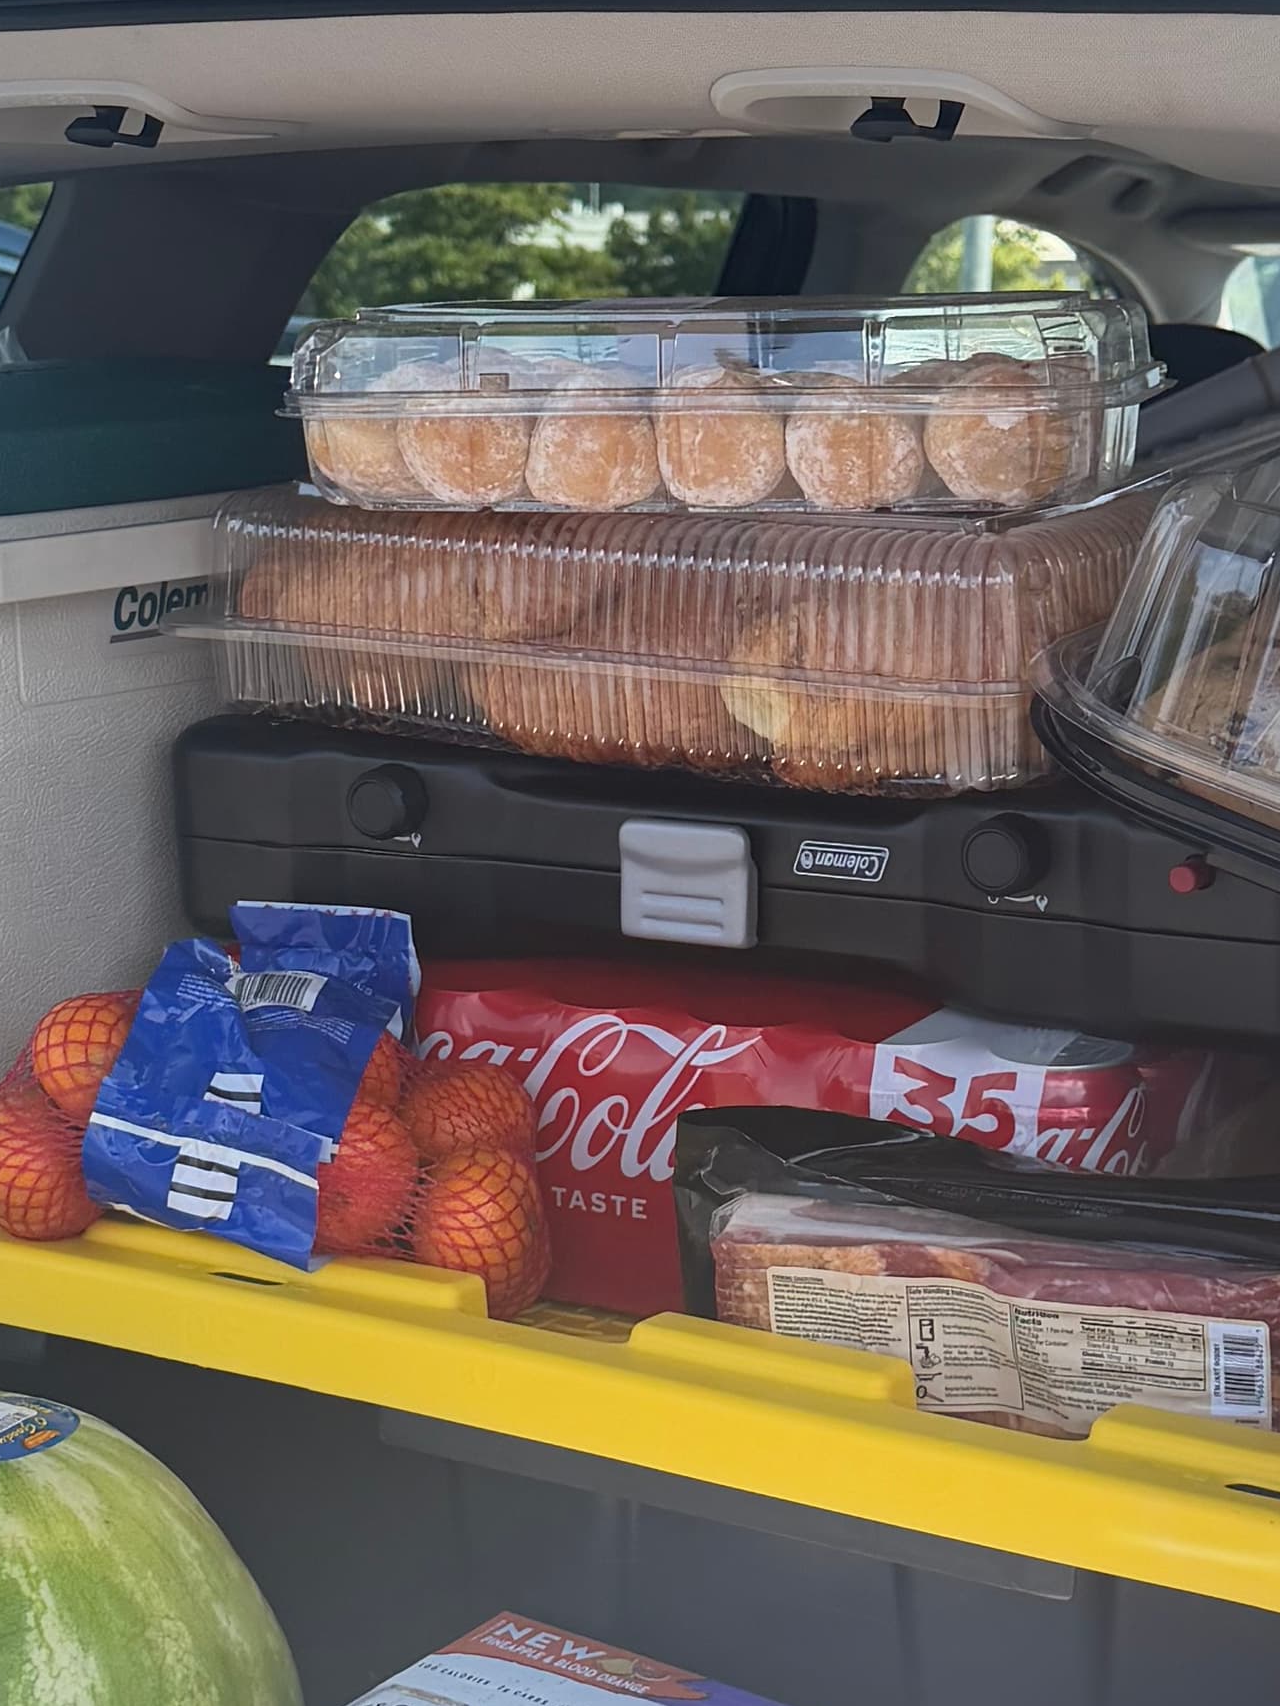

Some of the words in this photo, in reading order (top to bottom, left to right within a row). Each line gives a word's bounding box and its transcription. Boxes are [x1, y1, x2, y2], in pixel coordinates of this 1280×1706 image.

[114, 582, 208, 630] Colem
[815, 852, 879, 876] Coleman
[891, 1054, 1019, 1154] 35
[552, 1185, 648, 1220] TASTE
[481, 1635, 543, 1667] PINEAPPLE
[555, 1657, 597, 1681] BLOOD
[598, 1671, 650, 1694] ORANGE
[493, 1621, 609, 1663] NEW
